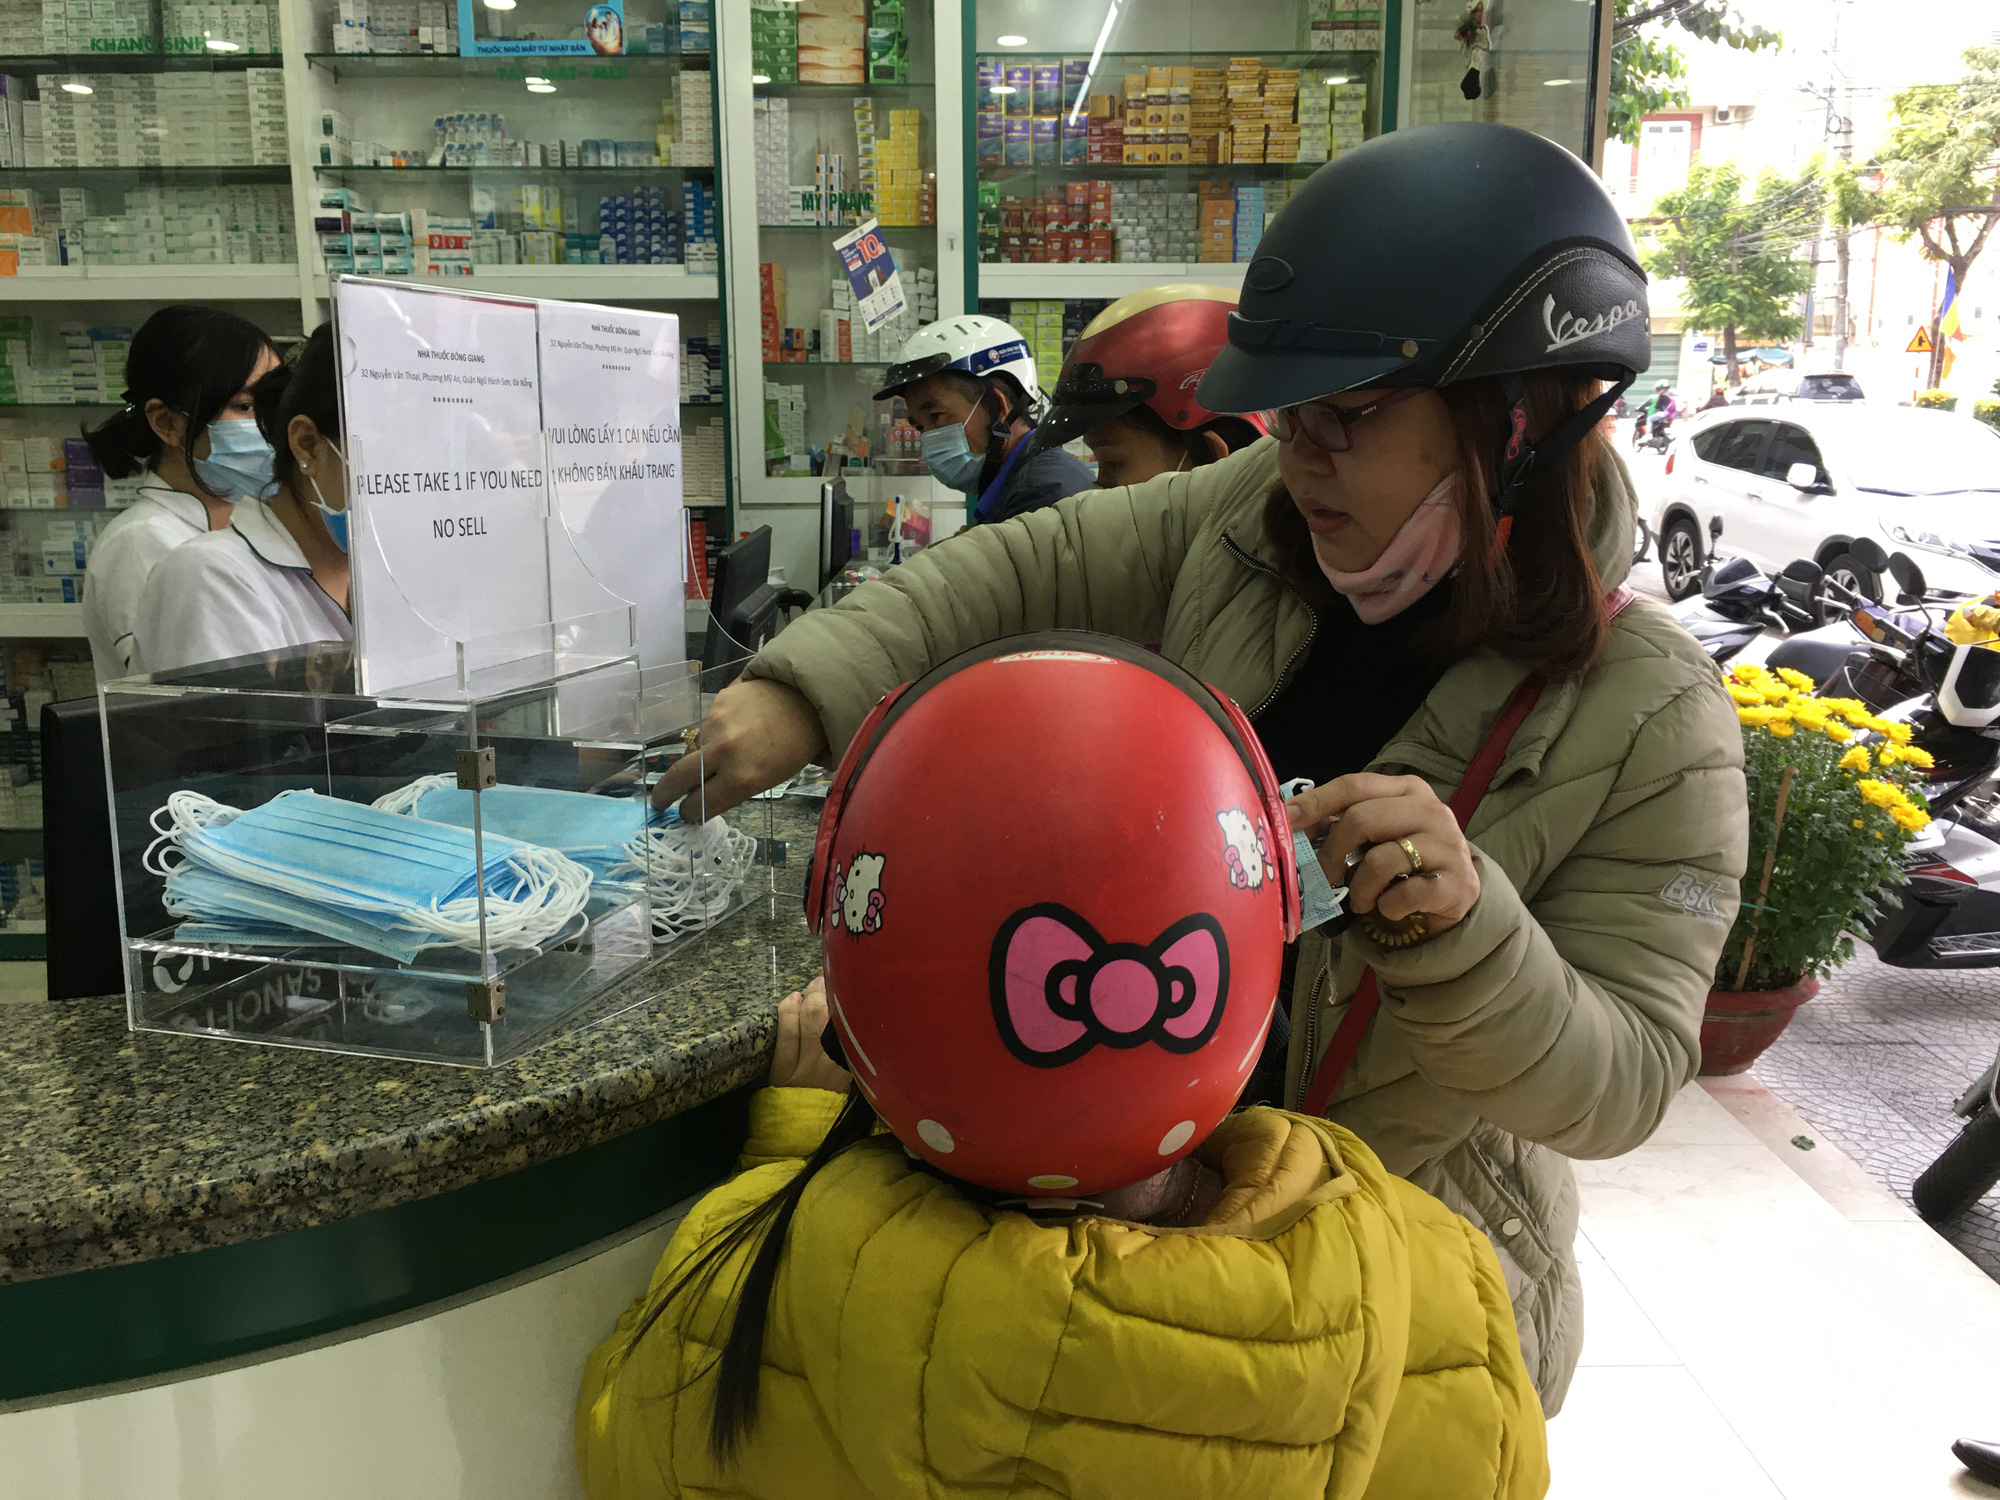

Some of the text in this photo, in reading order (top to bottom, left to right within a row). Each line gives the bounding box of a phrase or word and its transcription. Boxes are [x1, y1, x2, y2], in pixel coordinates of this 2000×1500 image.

[592, 324, 600, 332] NHÀ
[601, 324, 615, 334] THUỐC
[1543, 293, 1642, 353] Vespa
[550, 339, 556, 347] 32
[557, 339, 573, 349] Nguyễn
[418, 350, 485, 363] NHÀ THUỐC ĐÔNG GIANG
[361, 368, 368, 378] 32
[370, 368, 392, 380] Nguyễn
[394, 370, 404, 380] Văn
[422, 372, 443, 383] Phường
[444, 374, 452, 383] Mỹ
[462, 376, 476, 386] Quận
[476, 376, 487, 386] Ngũ
[488, 376, 500, 386] Hành
[512, 378, 520, 386] Đà
[520, 378, 533, 388] Nẵng
[548, 422, 680, 444] VUI LÒNG LẤY 1 CÁI NẾU CẦN
[558, 458, 674, 483] KHÔNG BÁN KHẨU TRANG
[357, 470, 542, 495] PLEASE TAKE 1 IF YOU NEED
[433, 516, 488, 539] NO SELL
